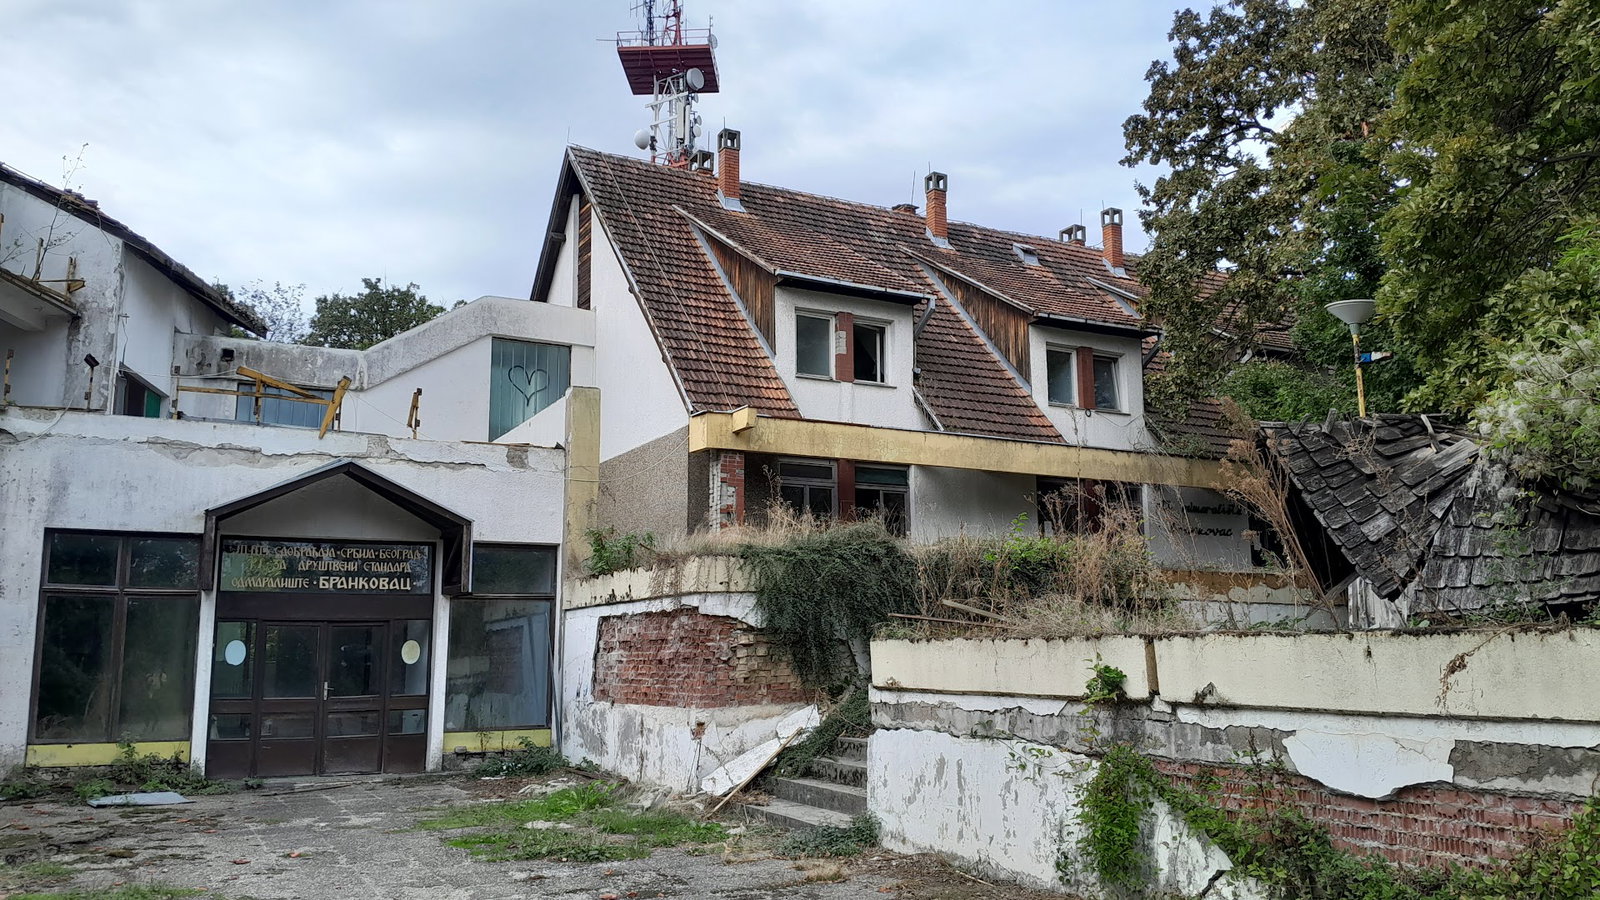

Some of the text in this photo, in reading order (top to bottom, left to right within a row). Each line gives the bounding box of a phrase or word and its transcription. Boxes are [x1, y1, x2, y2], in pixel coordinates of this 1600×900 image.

[340, 547, 376, 559] СРБИЈА
[379, 548, 420, 561] БЕОГРАД
[298, 560, 358, 572] ДРУШТВЕНИ
[231, 576, 411, 591] ОДМАРАЛИШТЕ БРАНКОВАЦ
